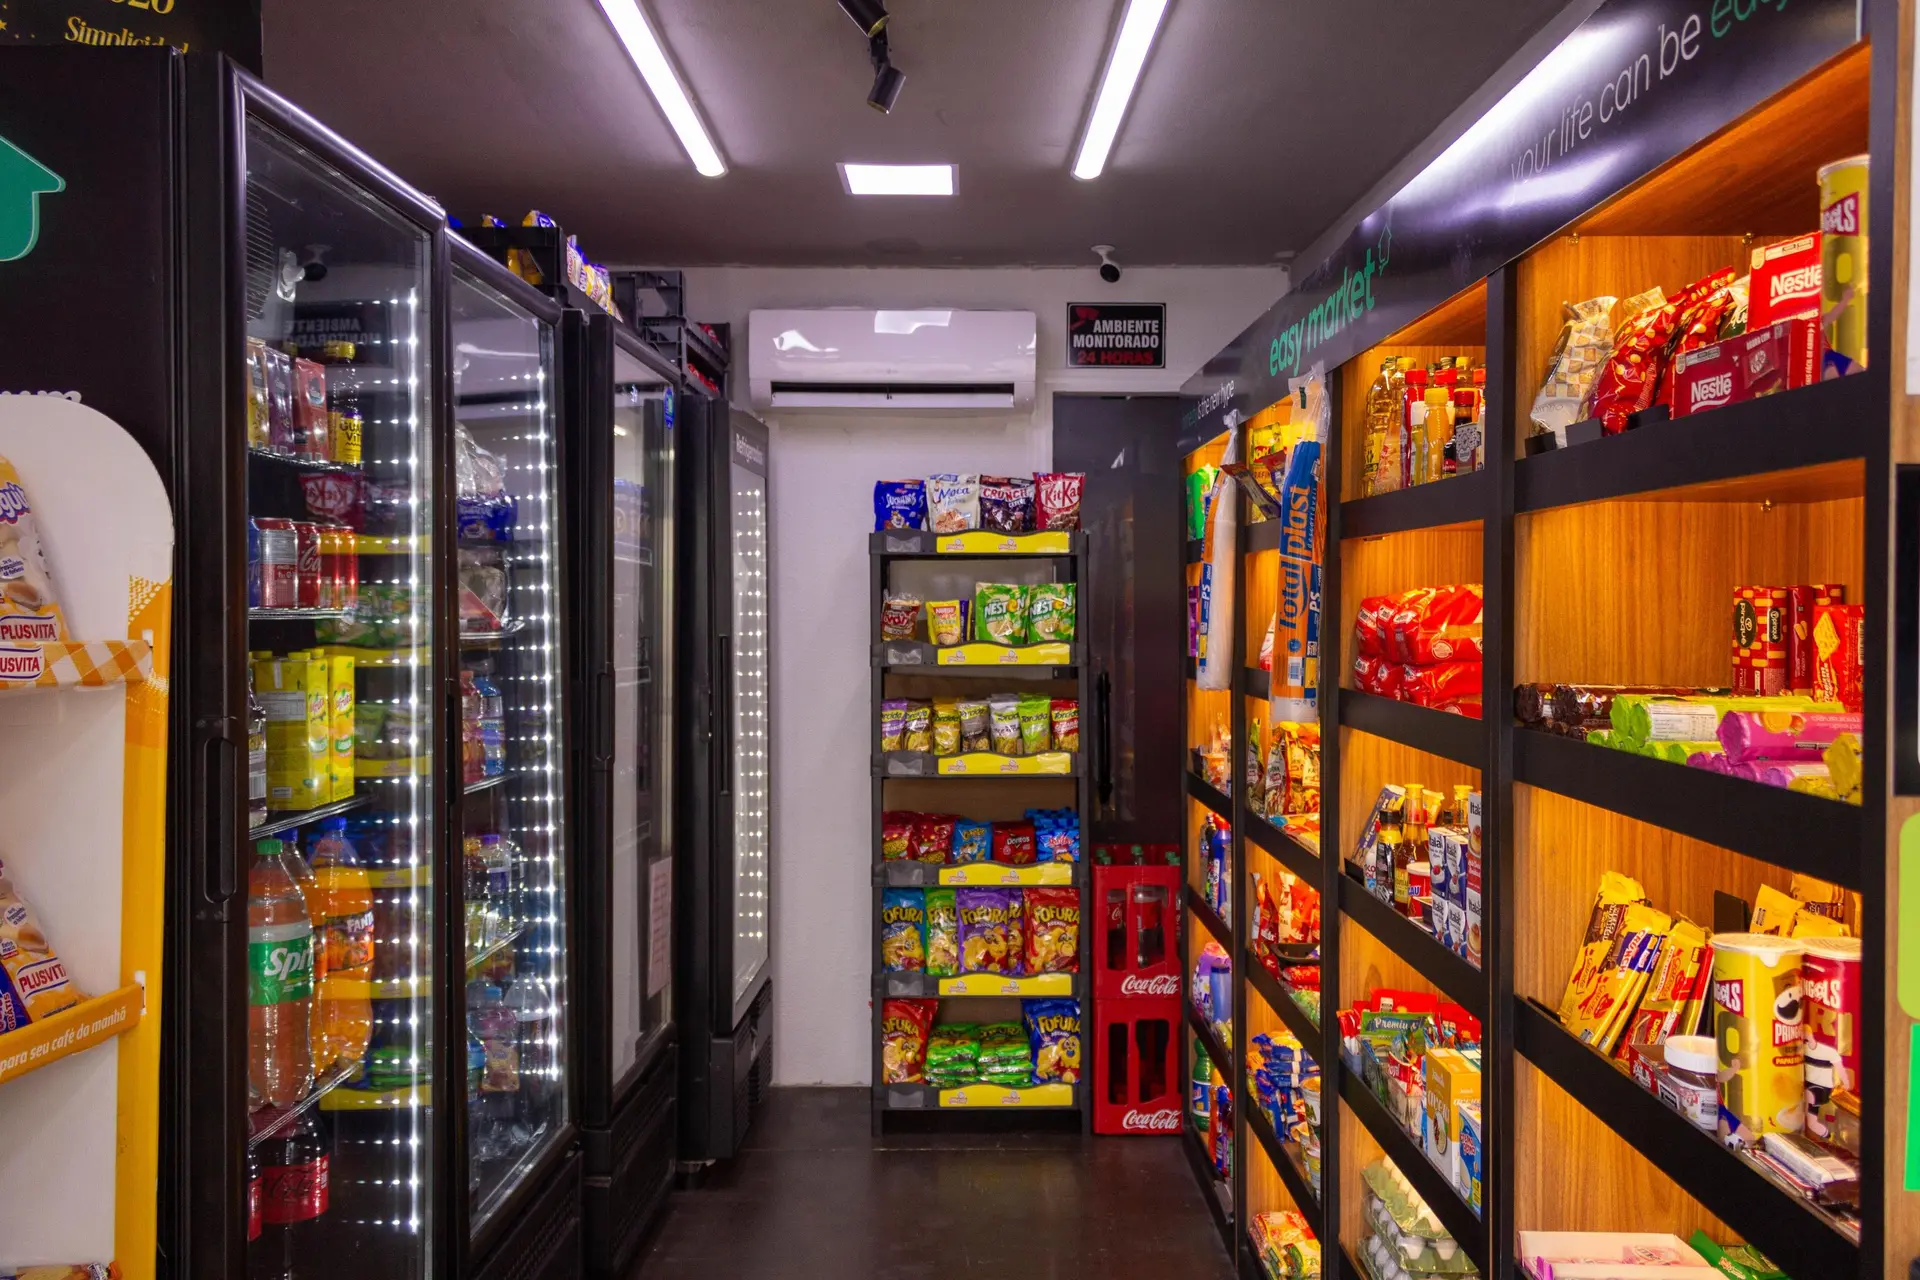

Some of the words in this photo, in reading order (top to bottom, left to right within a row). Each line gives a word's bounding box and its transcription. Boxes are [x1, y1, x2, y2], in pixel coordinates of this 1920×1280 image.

[1560, 96, 1593, 157] life
[1600, 52, 1649, 123] can
[1658, 13, 1700, 81] be
[1270, 318, 1304, 376] easy
[1307, 248, 1375, 352] market
[1093, 320, 1159, 333] AMBIENTE
[1073, 334, 1159, 348] MONITORADO
[1077, 351, 1096, 364] 24
[1100, 351, 1154, 364] HORAS
[983, 487, 1027, 500] CRUNCH
[1284, 484, 1311, 561] plast
[1202, 583, 1211, 600] PS
[1279, 561, 1300, 629] Total
[1309, 591, 1320, 613] PS
[1, 624, 56, 640] PLUSVITA
[1022, 713, 1048, 722] Torcida
[1007, 836, 1029, 845] Doritos
[960, 906, 1008, 924] FOFURA
[1033, 906, 1080, 924] FOFURA
[1618, 929, 1649, 974] CRUNCH
[4, 993, 16, 1031] GRÁTIS
[30, 1041, 49, 1060] seu
[51, 1028, 75, 1050] café
[76, 1023, 90, 1040] da
[91, 1006, 126, 1034] manhã
[1037, 1015, 1081, 1034] FOFURA
